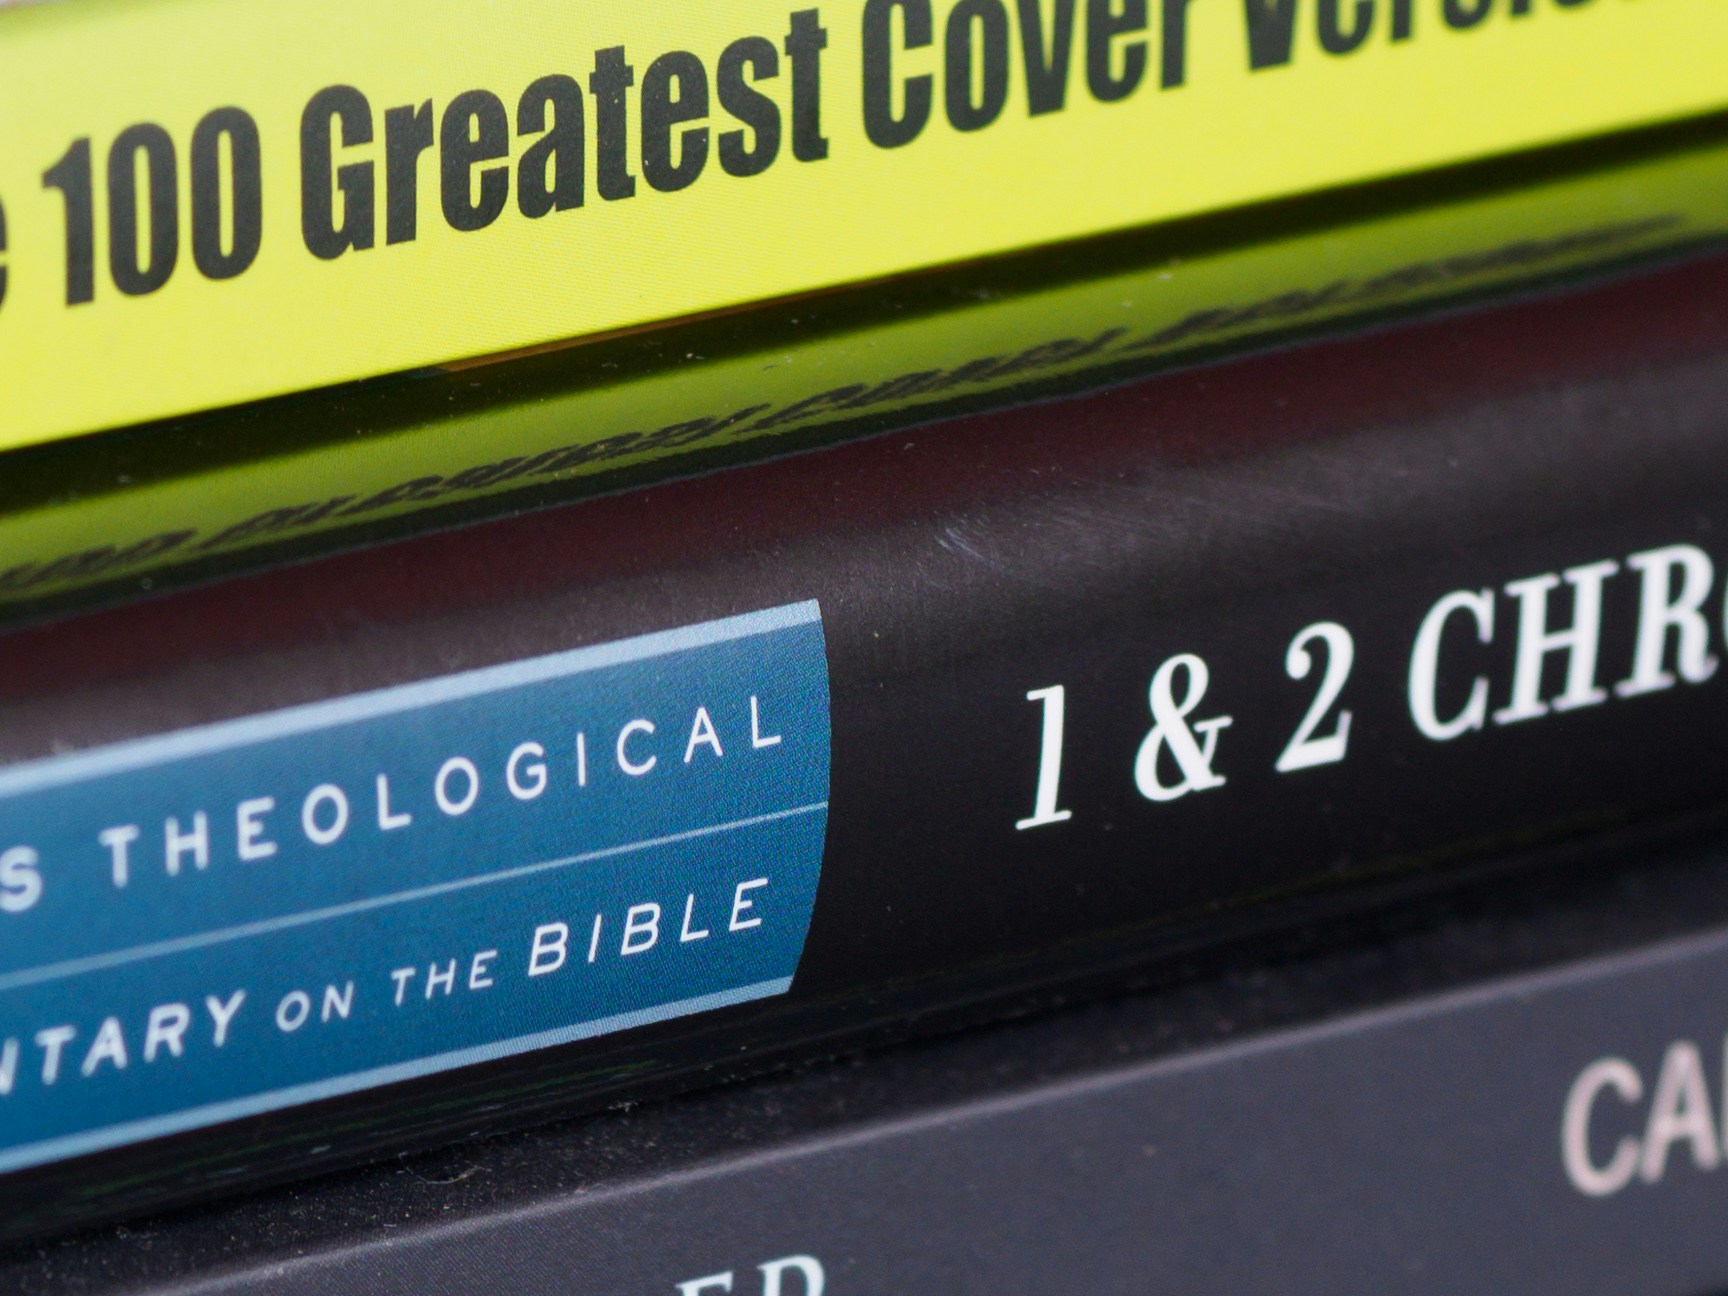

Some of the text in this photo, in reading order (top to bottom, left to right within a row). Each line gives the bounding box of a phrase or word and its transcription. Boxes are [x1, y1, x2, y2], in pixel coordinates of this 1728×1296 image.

[41, 106, 263, 308] 100
[299, 9, 830, 263] Greatest
[862, 0, 1190, 150] Cover
[98, 695, 782, 888] THEOLOGICAL
[1014, 683, 1073, 833] 1
[1132, 652, 1234, 804] &
[1274, 622, 1355, 774] 2
[275, 981, 356, 1035] ON
[391, 949, 500, 1010] THE
[526, 878, 771, 979] BIBLE
